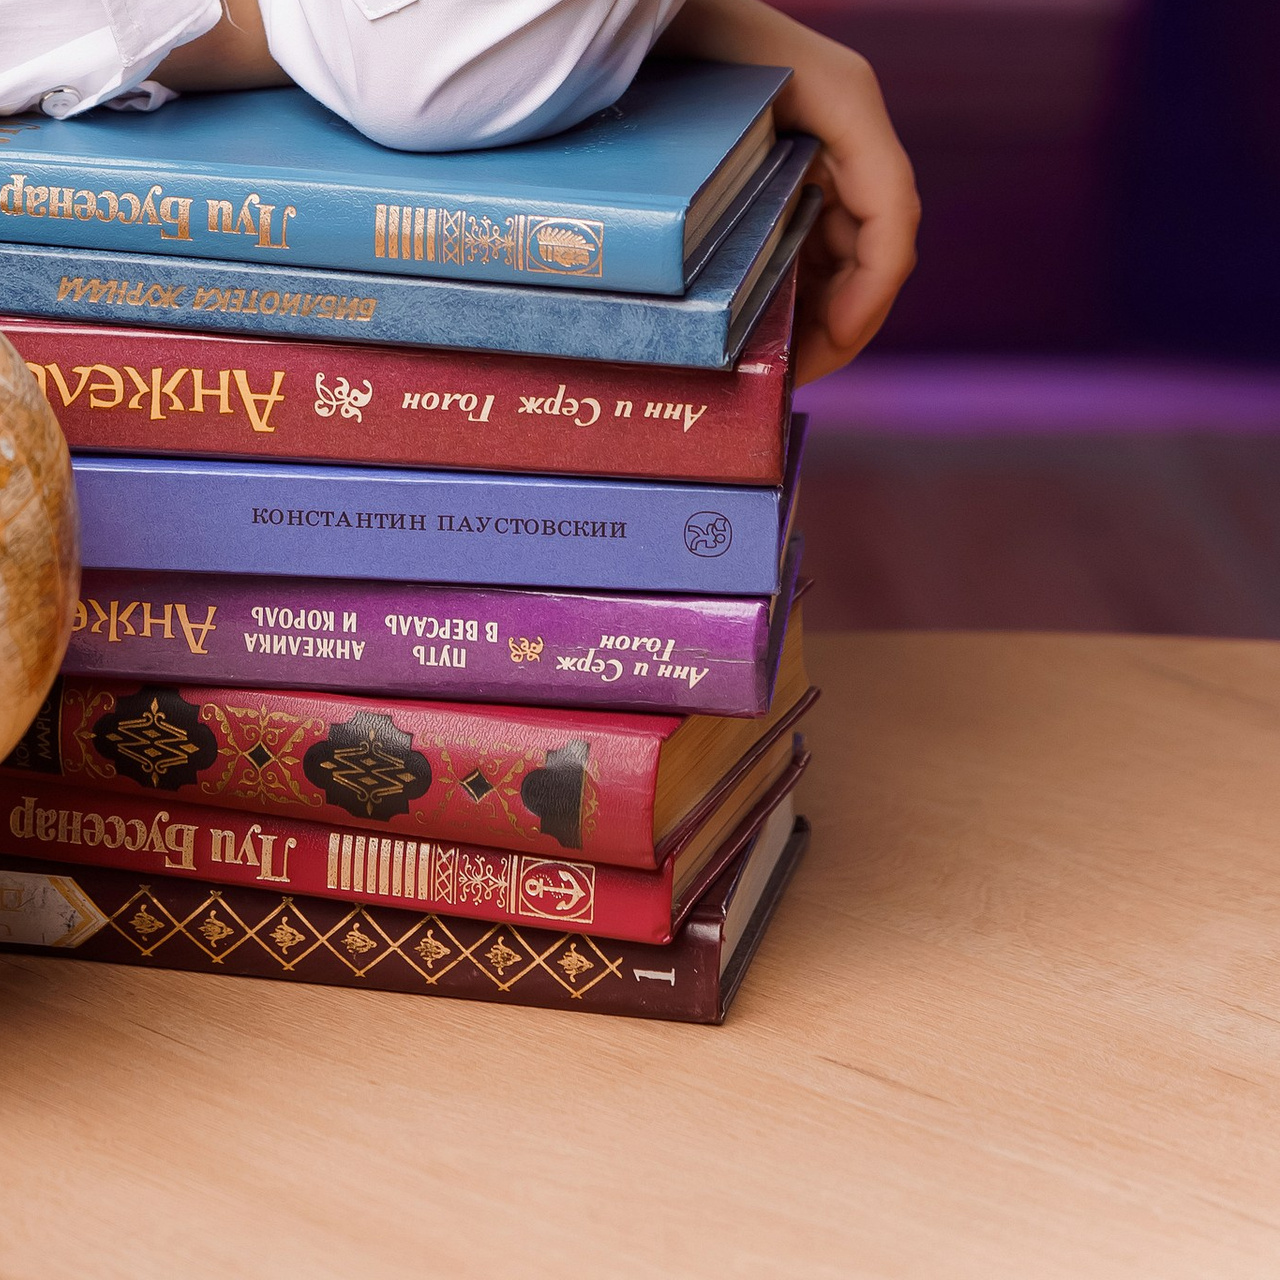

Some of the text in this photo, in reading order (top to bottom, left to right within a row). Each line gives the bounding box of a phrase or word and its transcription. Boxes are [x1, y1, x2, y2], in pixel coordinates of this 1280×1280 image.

[206, 191, 298, 249] Луи
[57, 274, 187, 309] ЖУРНАЛА
[193, 285, 378, 323] БИБЛИОТЕКА
[401, 391, 496, 423] Голон
[517, 384, 602, 427] Серж
[614, 400, 633, 418] и
[643, 401, 708, 433] Анн
[251, 507, 628, 539] КОНСТАНТИН ПАУСТОВСКИЙ
[251, 606, 358, 633] И КОРОЛЬ
[384, 614, 499, 643] В ВЕРСАЛЬ
[243, 632, 366, 661] АНЖЕЛИКА
[412, 644, 467, 669] ПУТЬ
[599, 634, 677, 663] Голон
[556, 646, 711, 690] Анн и Серж
[9, 796, 298, 883] Луи Буссенар
